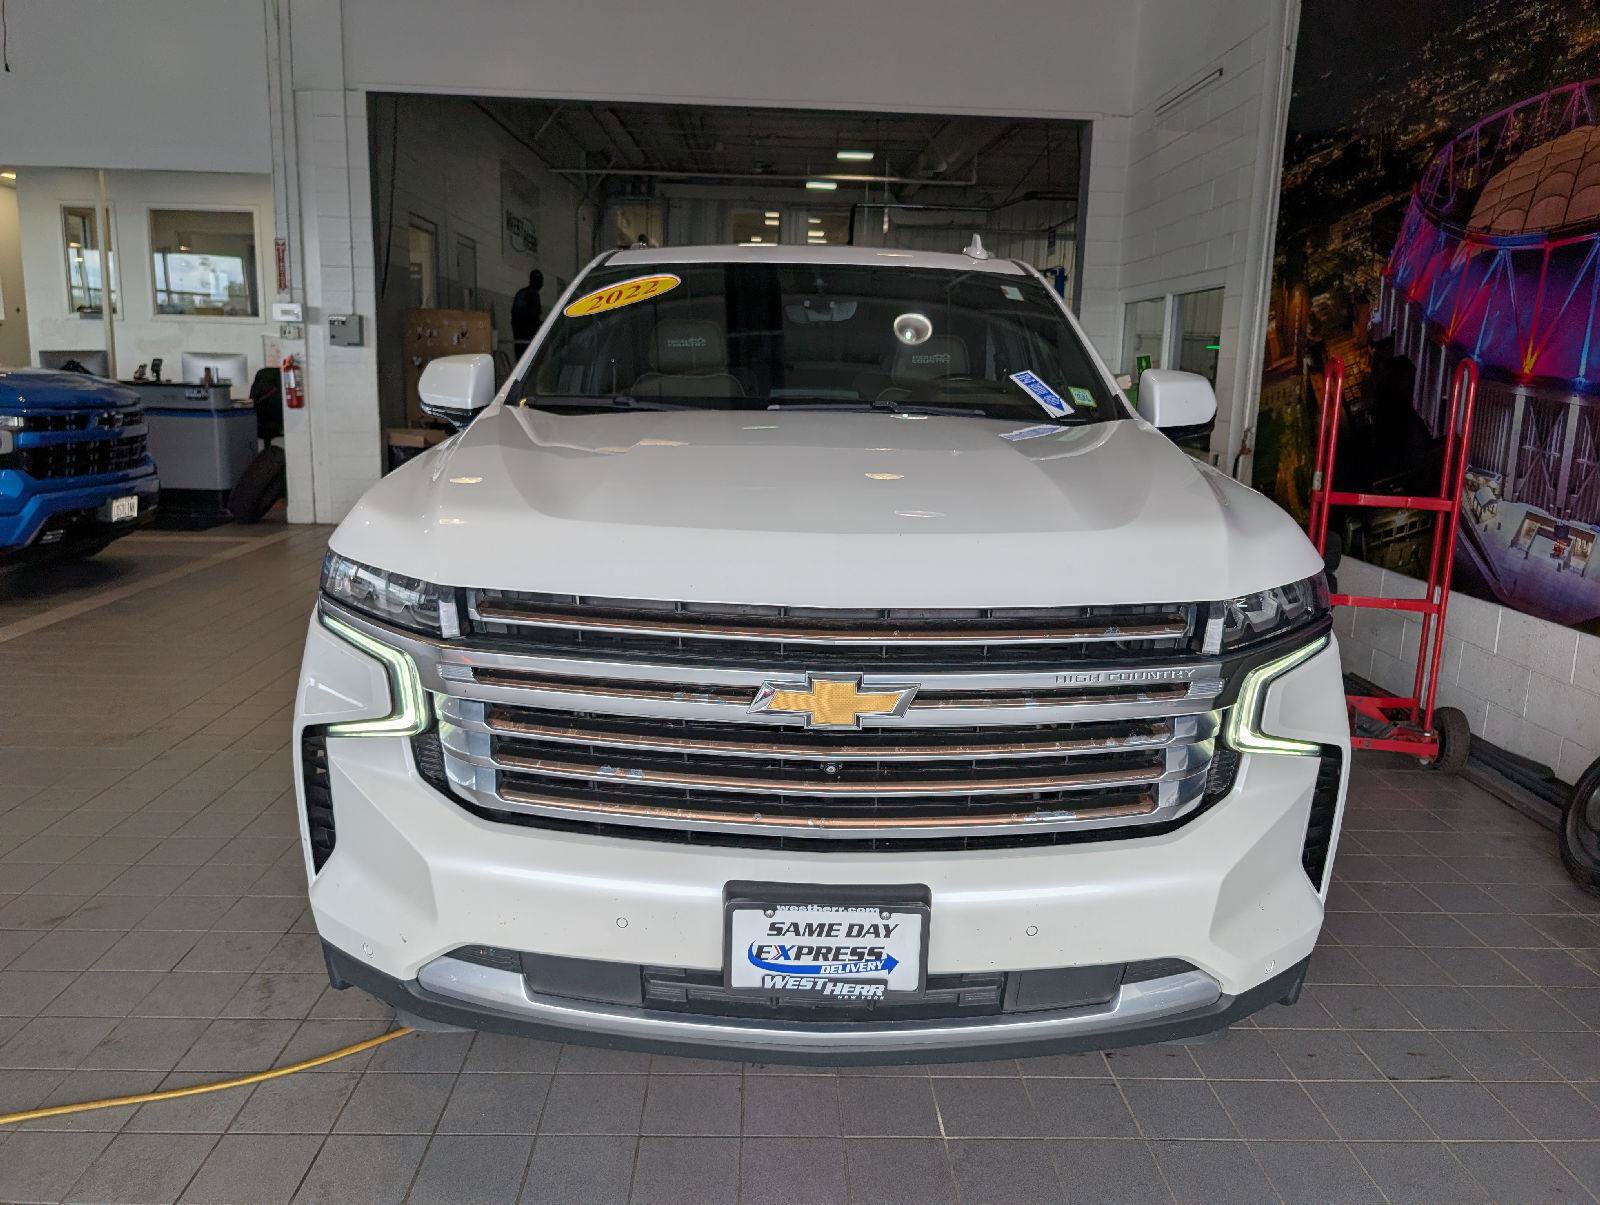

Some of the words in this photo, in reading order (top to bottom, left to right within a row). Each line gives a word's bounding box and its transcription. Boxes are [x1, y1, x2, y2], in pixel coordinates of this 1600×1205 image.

[585, 280, 659, 312] 2022
[1055, 674, 1101, 684] HIGH
[1108, 669, 1196, 681] COUNTRY
[776, 904, 880, 913] westherr.com
[767, 921, 842, 938] SAME
[845, 923, 900, 939] DAY
[754, 944, 885, 962] EXPRESS
[820, 960, 885, 975] DELIVERY
